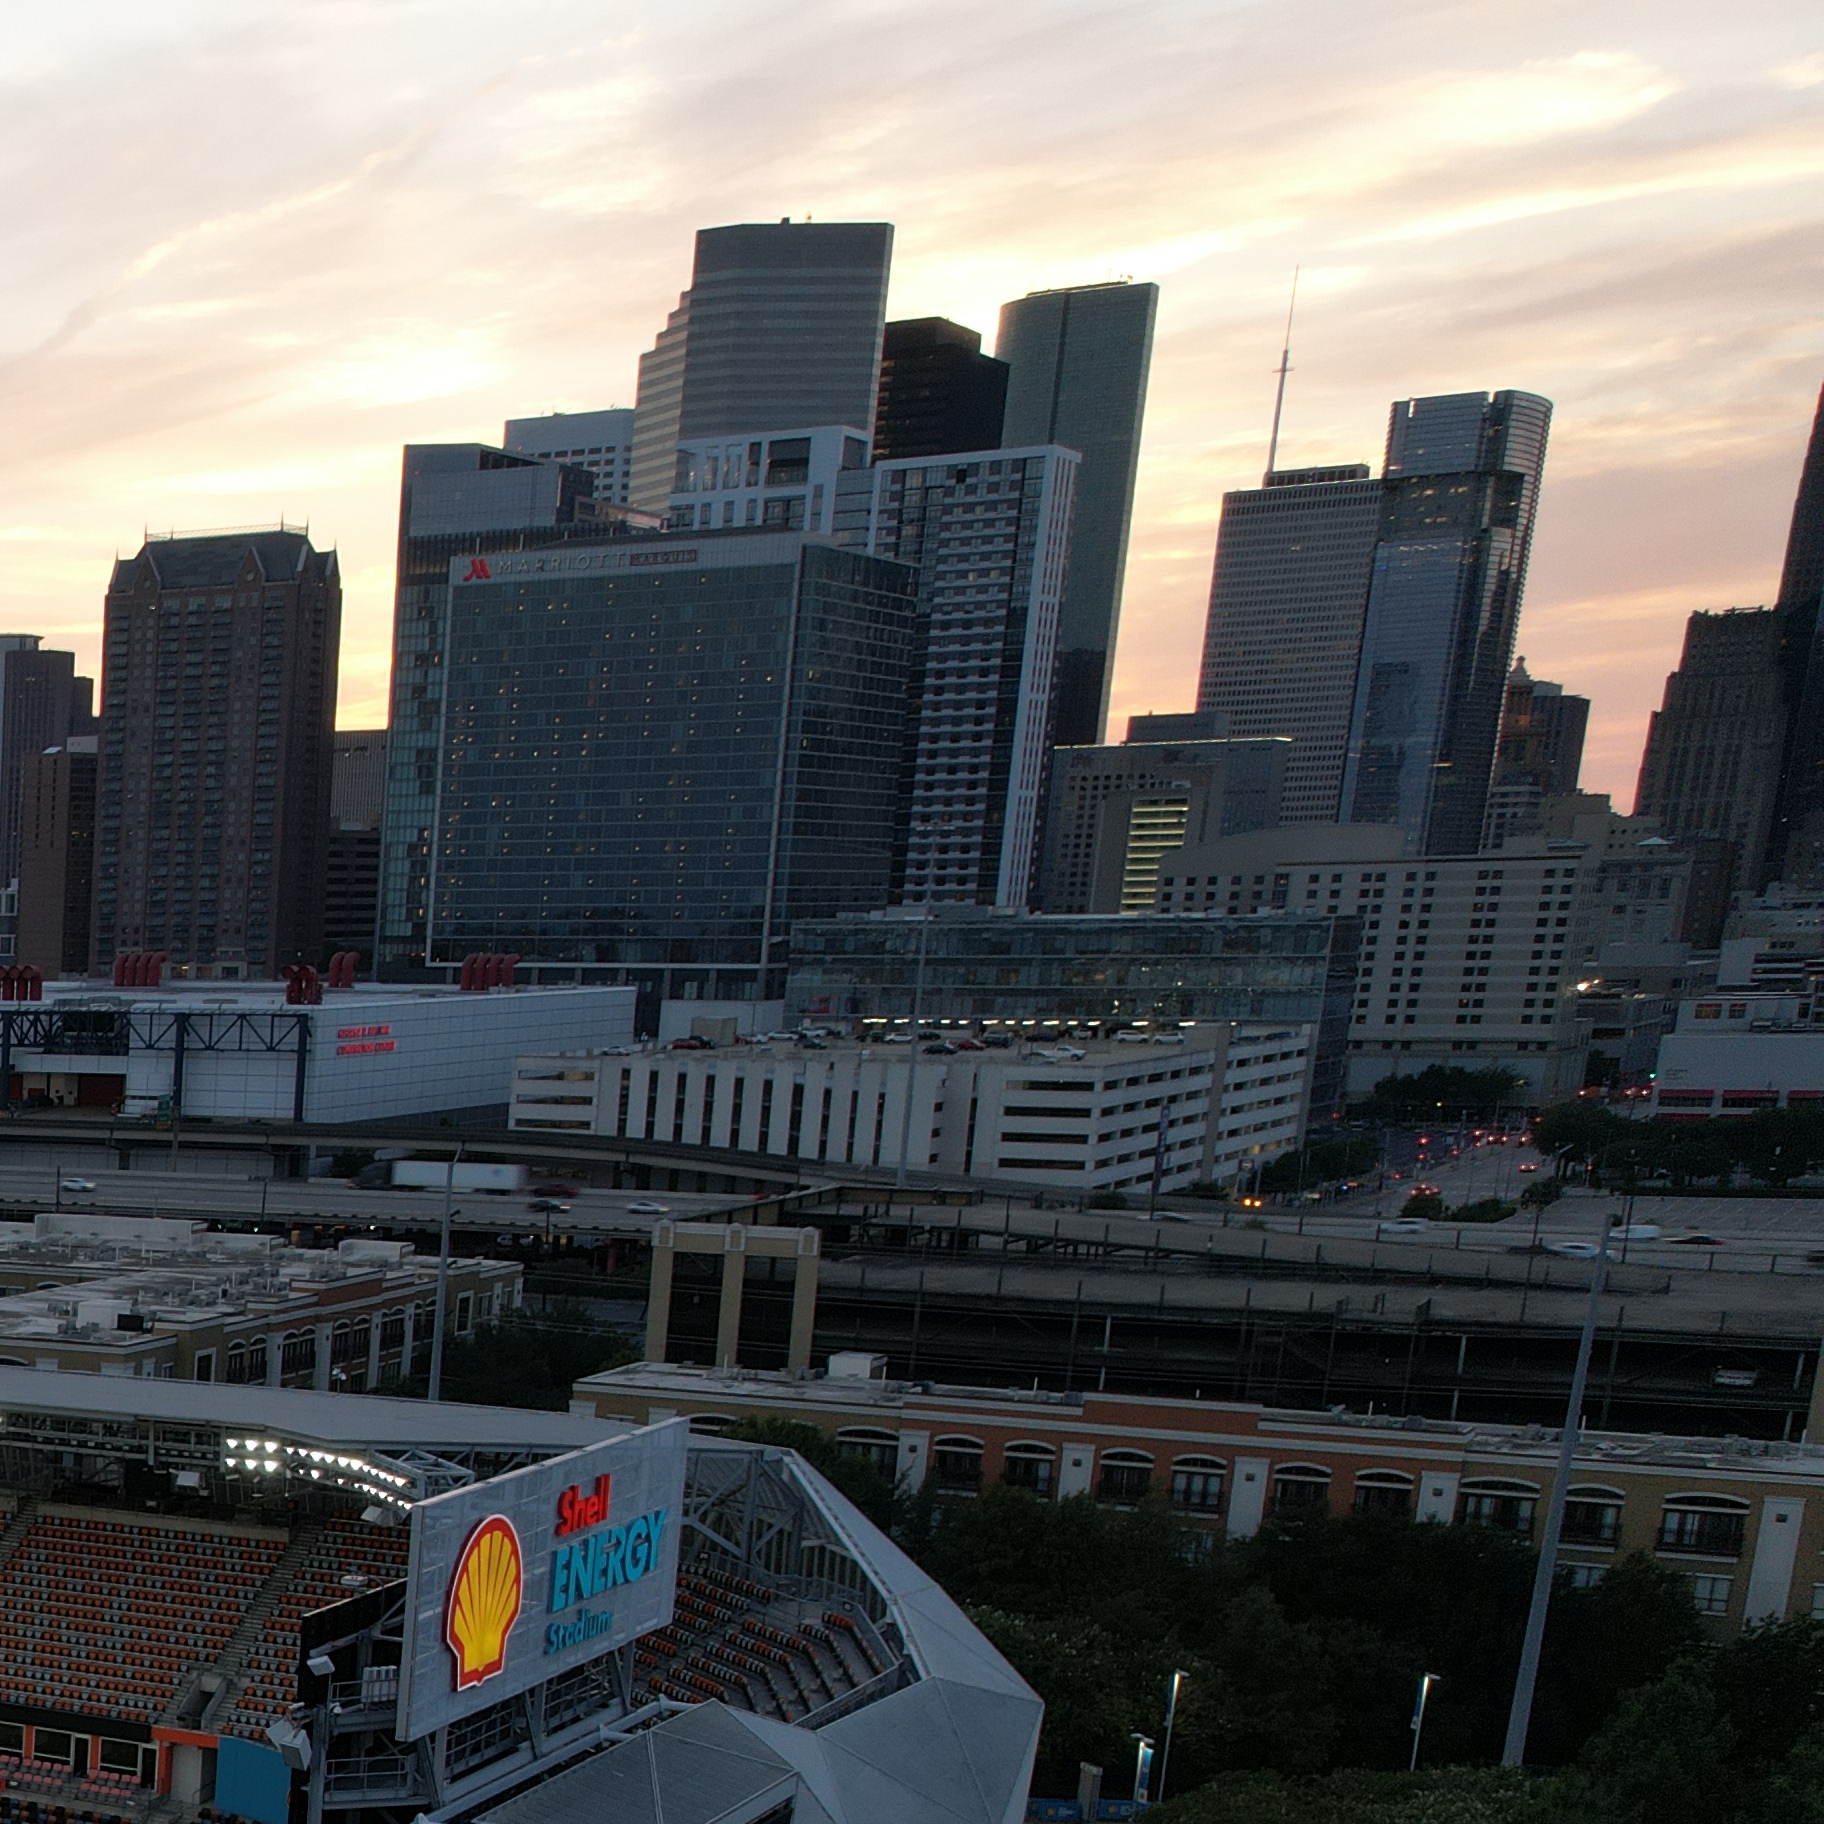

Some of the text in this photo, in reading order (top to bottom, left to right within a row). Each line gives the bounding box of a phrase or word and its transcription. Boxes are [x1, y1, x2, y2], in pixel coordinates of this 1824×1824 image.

[498, 550, 695, 574] MARRIOTT MARQUIS
[555, 1473, 612, 1537] Shell
[548, 1508, 669, 1614] ENERGY
[544, 1608, 612, 1655] Stadium
